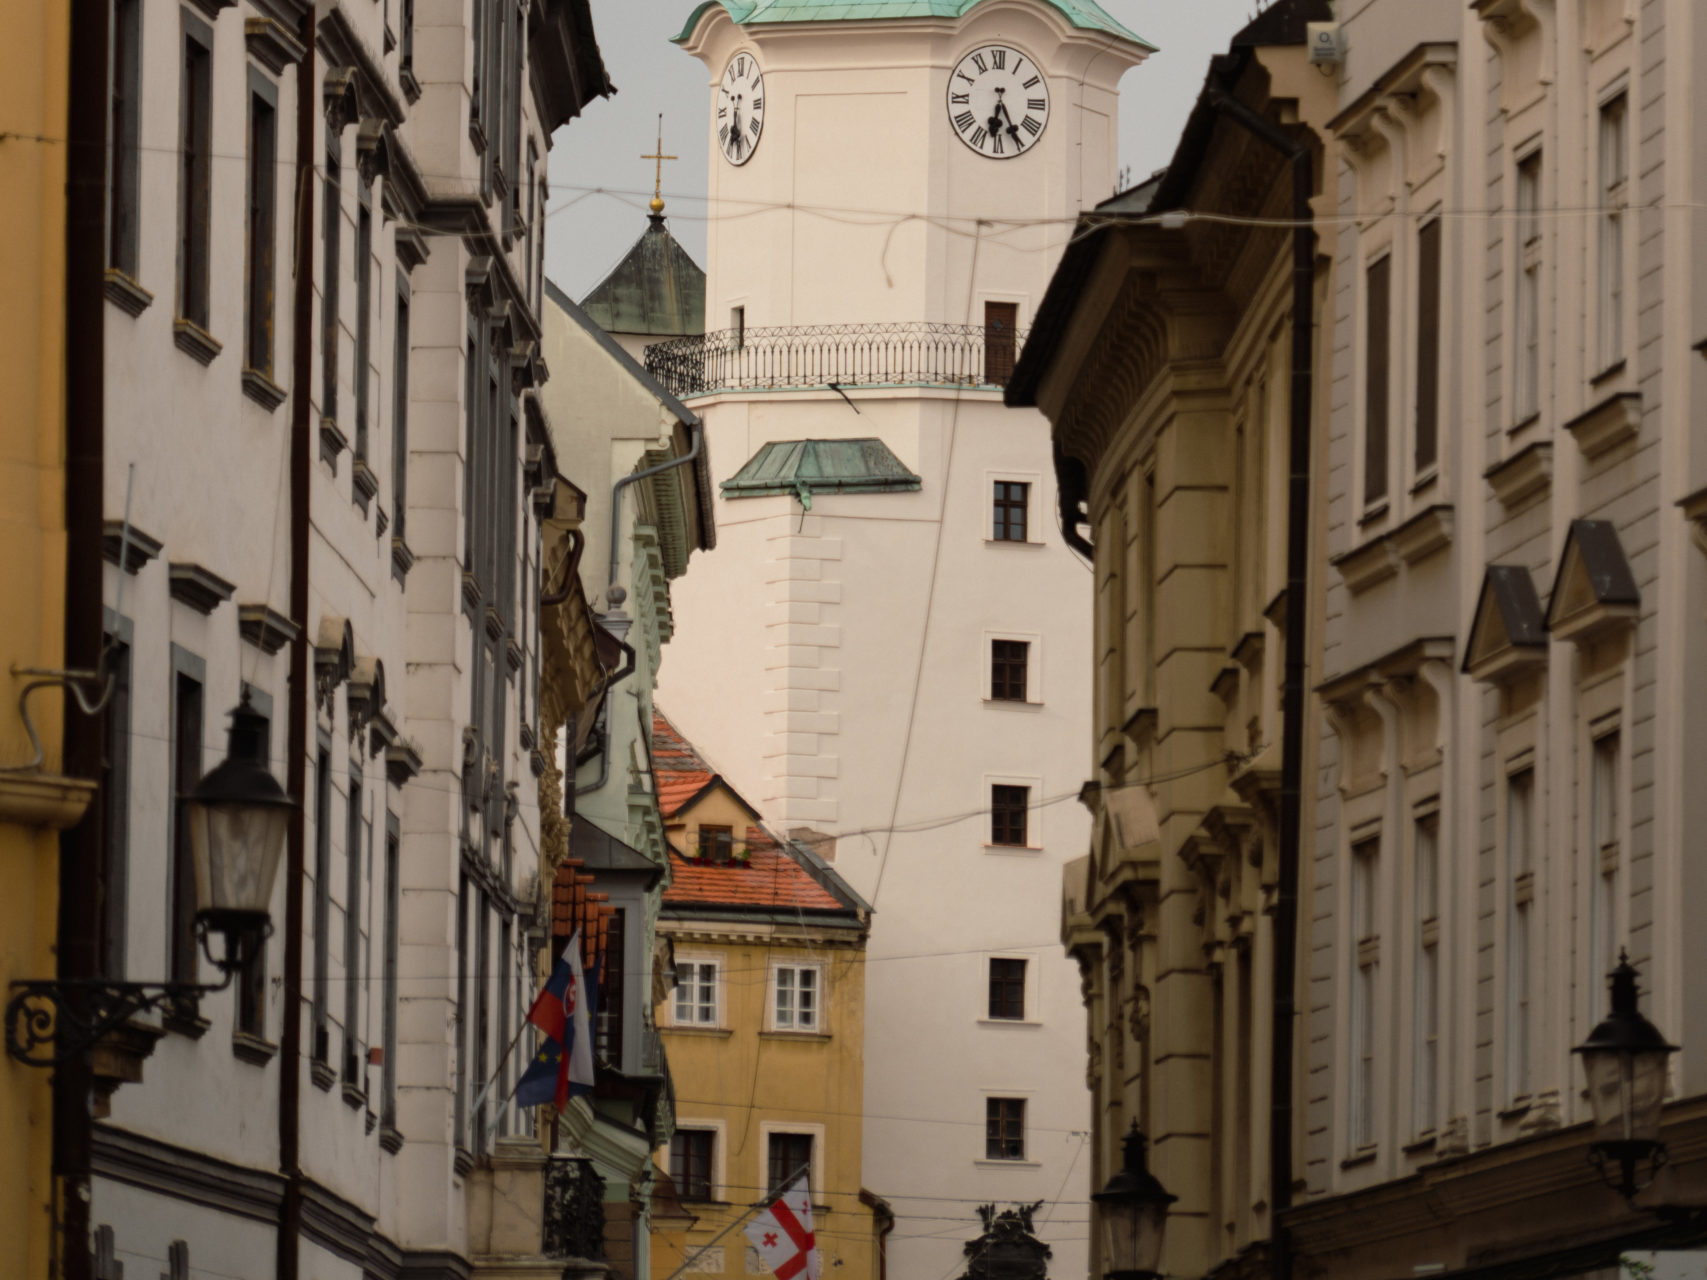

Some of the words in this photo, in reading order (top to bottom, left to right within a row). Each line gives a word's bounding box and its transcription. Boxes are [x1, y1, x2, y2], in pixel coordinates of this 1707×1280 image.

[971, 53, 988, 76] XI
[991, 50, 1006, 70] XII
[1012, 57, 1023, 75] I
[957, 70, 975, 86] X
[1022, 75, 1041, 90] II
[753, 98, 762, 110] III
[951, 92, 969, 104] IX
[1027, 98, 1046, 111] III
[1021, 114, 1042, 137] IIII
